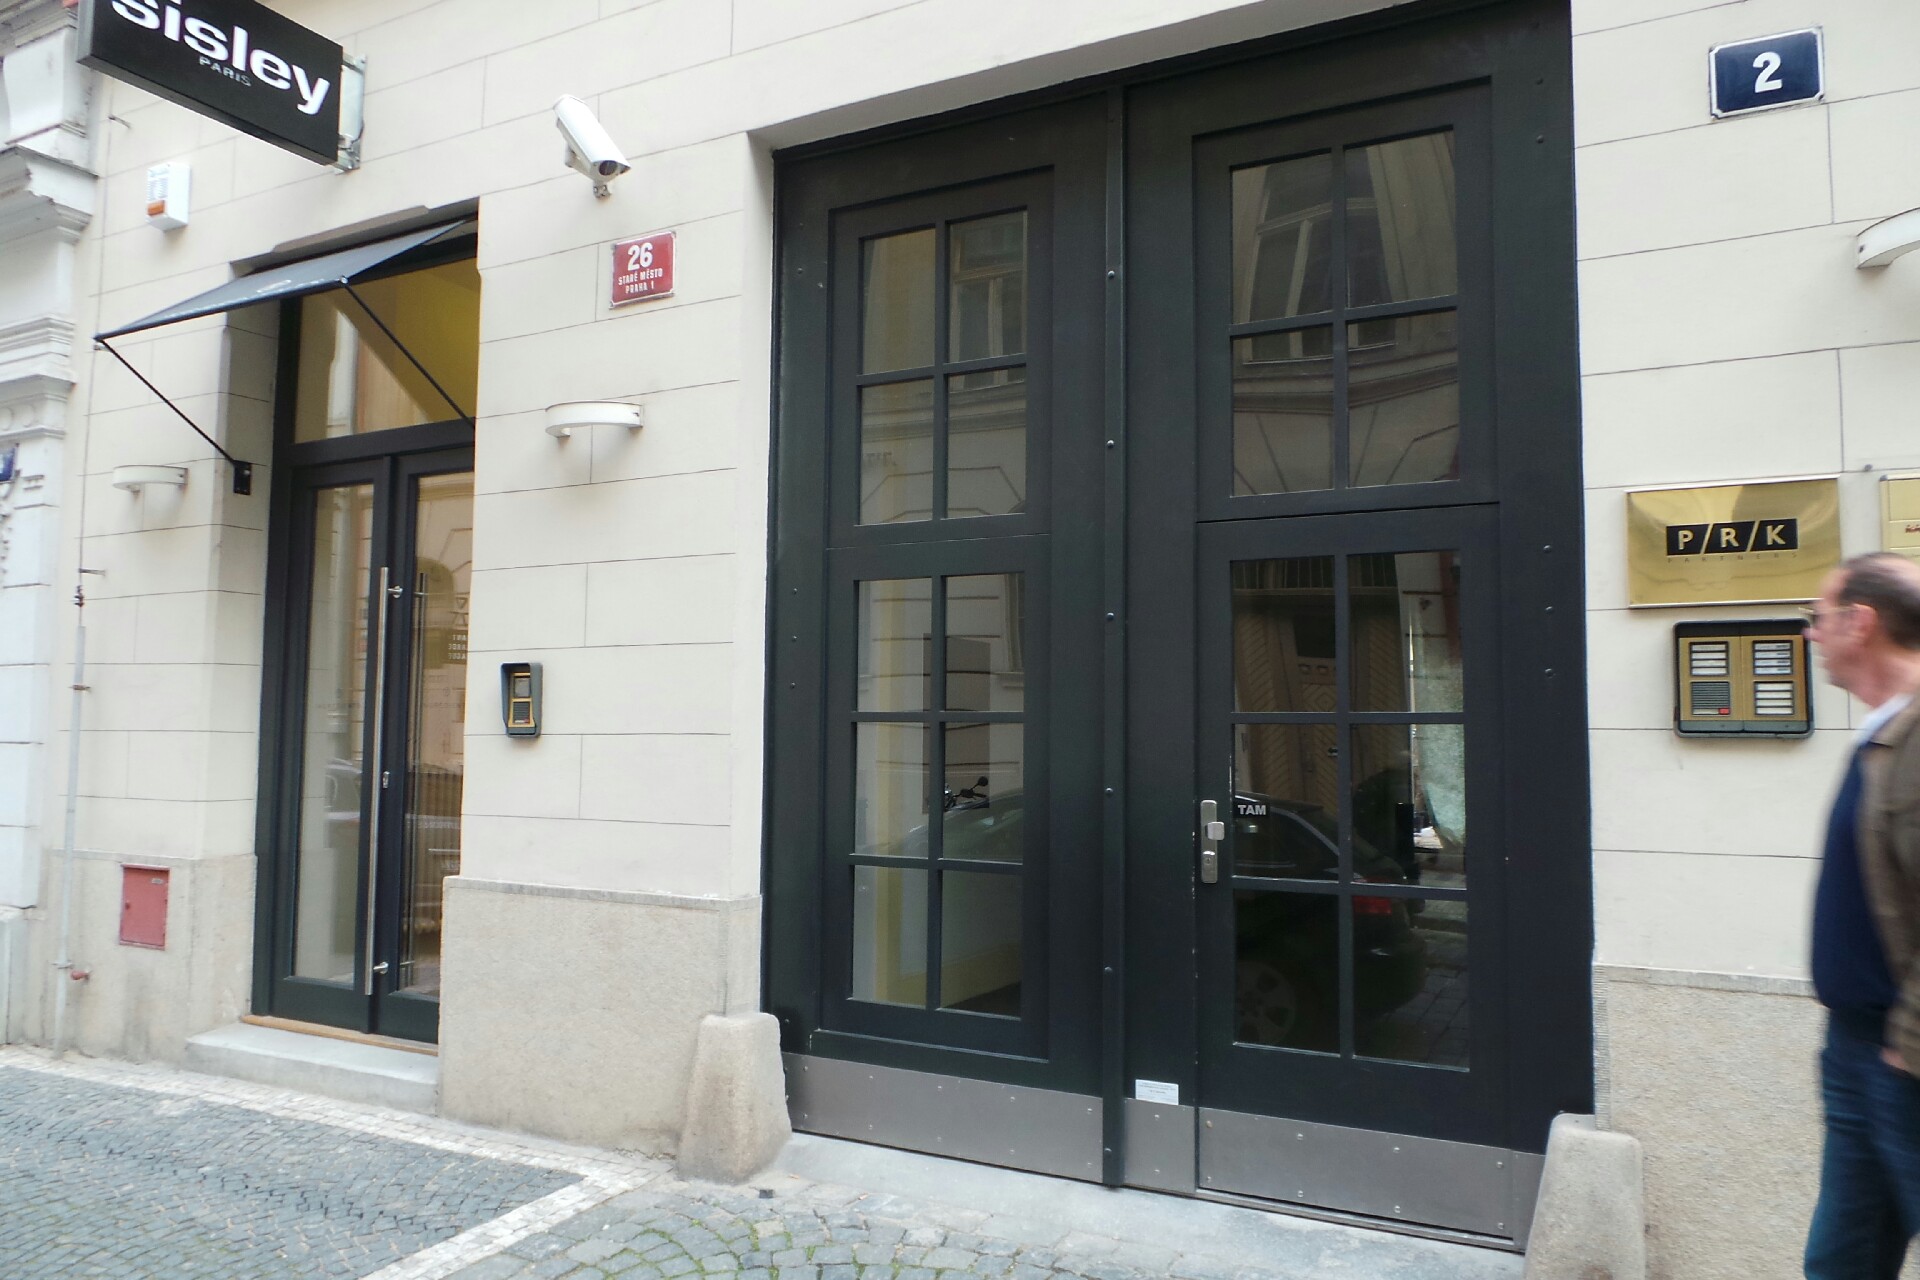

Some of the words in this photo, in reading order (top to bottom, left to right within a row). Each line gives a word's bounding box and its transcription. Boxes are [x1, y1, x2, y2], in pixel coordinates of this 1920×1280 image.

[112, 0, 331, 116] sisley
[198, 56, 252, 87] PARIS
[1752, 51, 1782, 93] 2
[627, 242, 653, 271] 26
[625, 281, 648, 294] PRAHA
[1237, 804, 1267, 816] TAM
